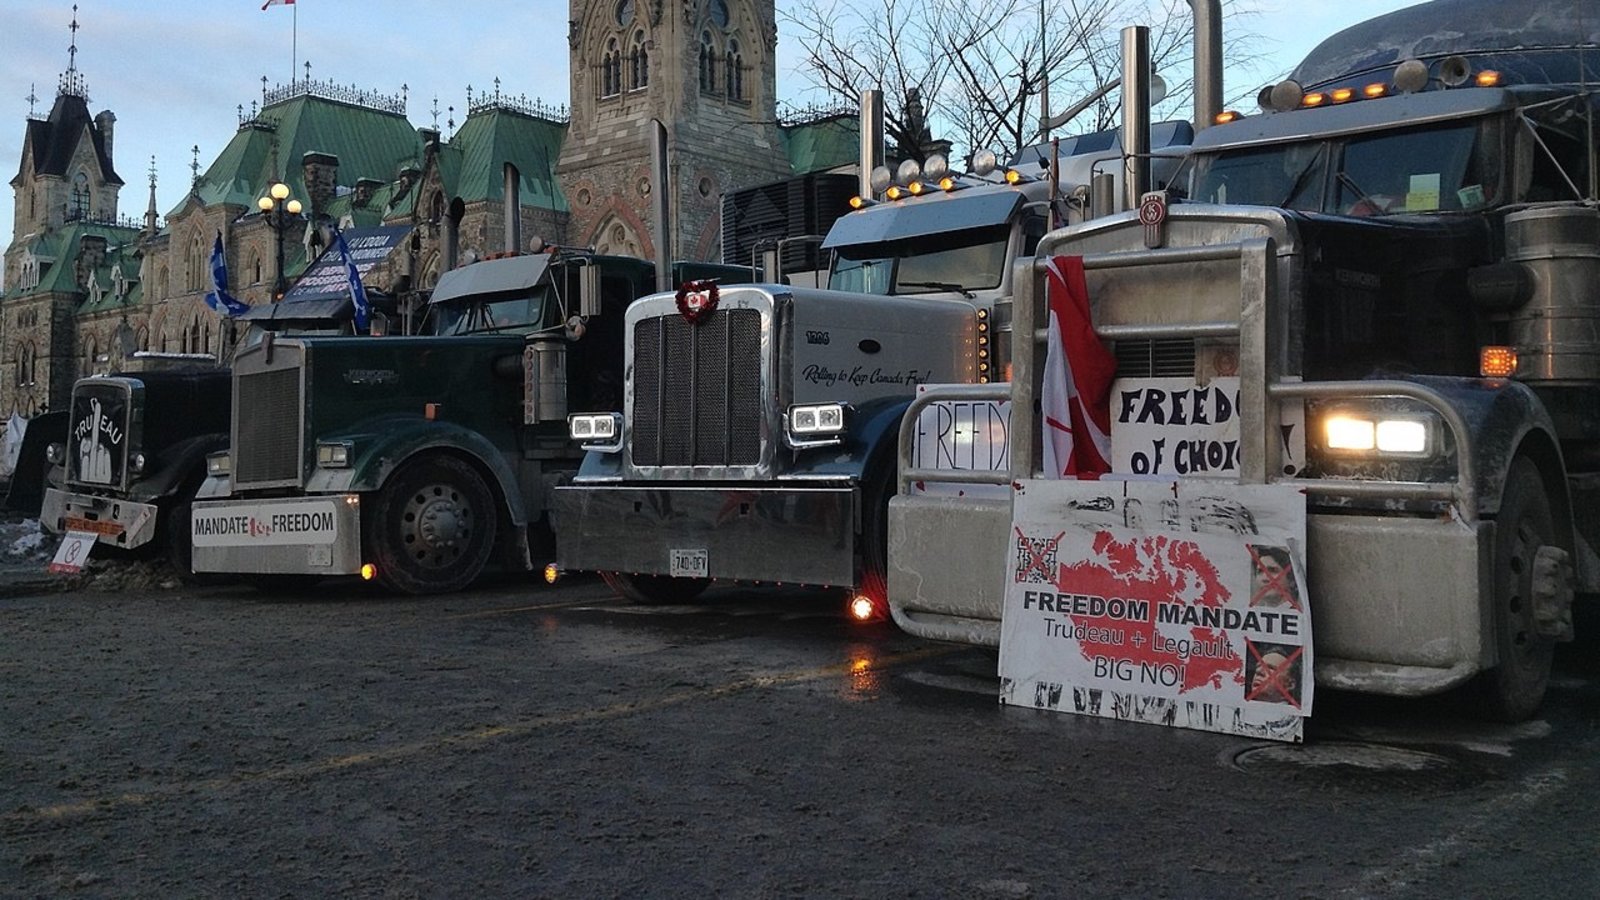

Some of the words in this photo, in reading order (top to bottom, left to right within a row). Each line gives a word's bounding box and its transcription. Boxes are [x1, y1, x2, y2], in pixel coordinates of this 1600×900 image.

[806, 330, 830, 345] 1206
[802, 364, 837, 387] Rolling
[838, 369, 848, 381] to
[869, 368, 903, 384] Canada
[1118, 386, 1241, 426] FREED
[1174, 439, 1241, 475] CHOI
[195, 516, 249, 536] MANDATE
[272, 512, 334, 533] FREEDOM
[1023, 590, 1149, 622] FREEDOM
[1158, 604, 1300, 637] MANDATE
[1044, 618, 1124, 644] Trudeau
[1152, 634, 1234, 661] Legault
[1094, 656, 1134, 682] BIG
[1140, 663, 1186, 690] NO!
